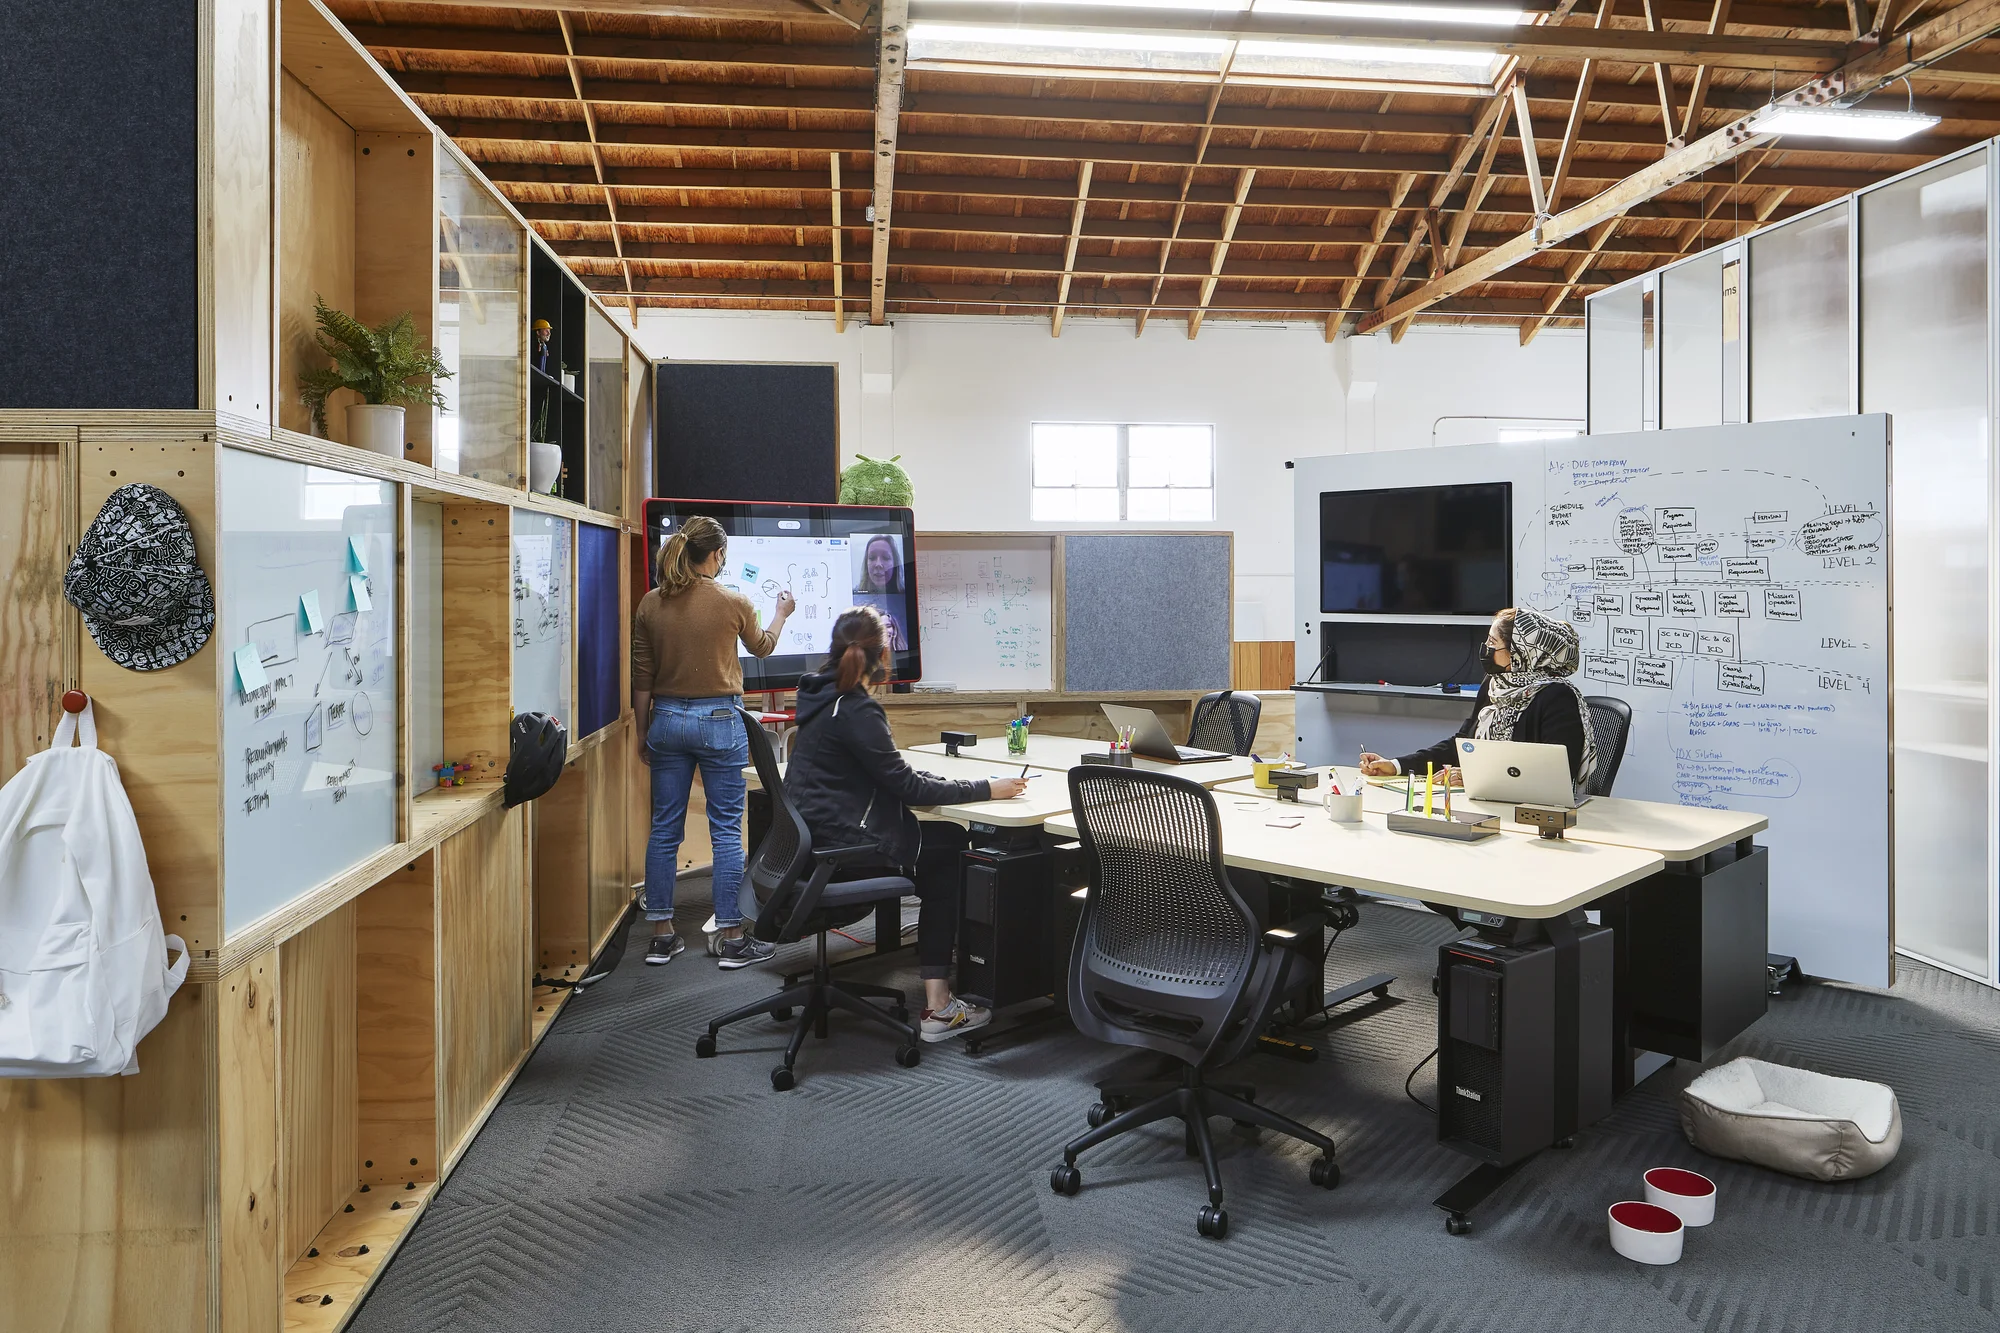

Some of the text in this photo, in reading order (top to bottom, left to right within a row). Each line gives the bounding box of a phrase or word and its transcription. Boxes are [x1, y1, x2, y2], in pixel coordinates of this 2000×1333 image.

[1723, 286, 1737, 297] ms
[1592, 459, 1627, 467] TOMORROW
[1550, 503, 1584, 512] SCHEDULE
[1829, 503, 1859, 516] LEVEL
[1823, 556, 1877, 569] LEVEL 2
[131, 628, 208, 666] GIANTS
[1619, 637, 1634, 645] ICD
[1706, 645, 1724, 654] ICD
[1818, 674, 1852, 692] LEVEL
[1455, 1085, 1481, 1102] ThinkStation
